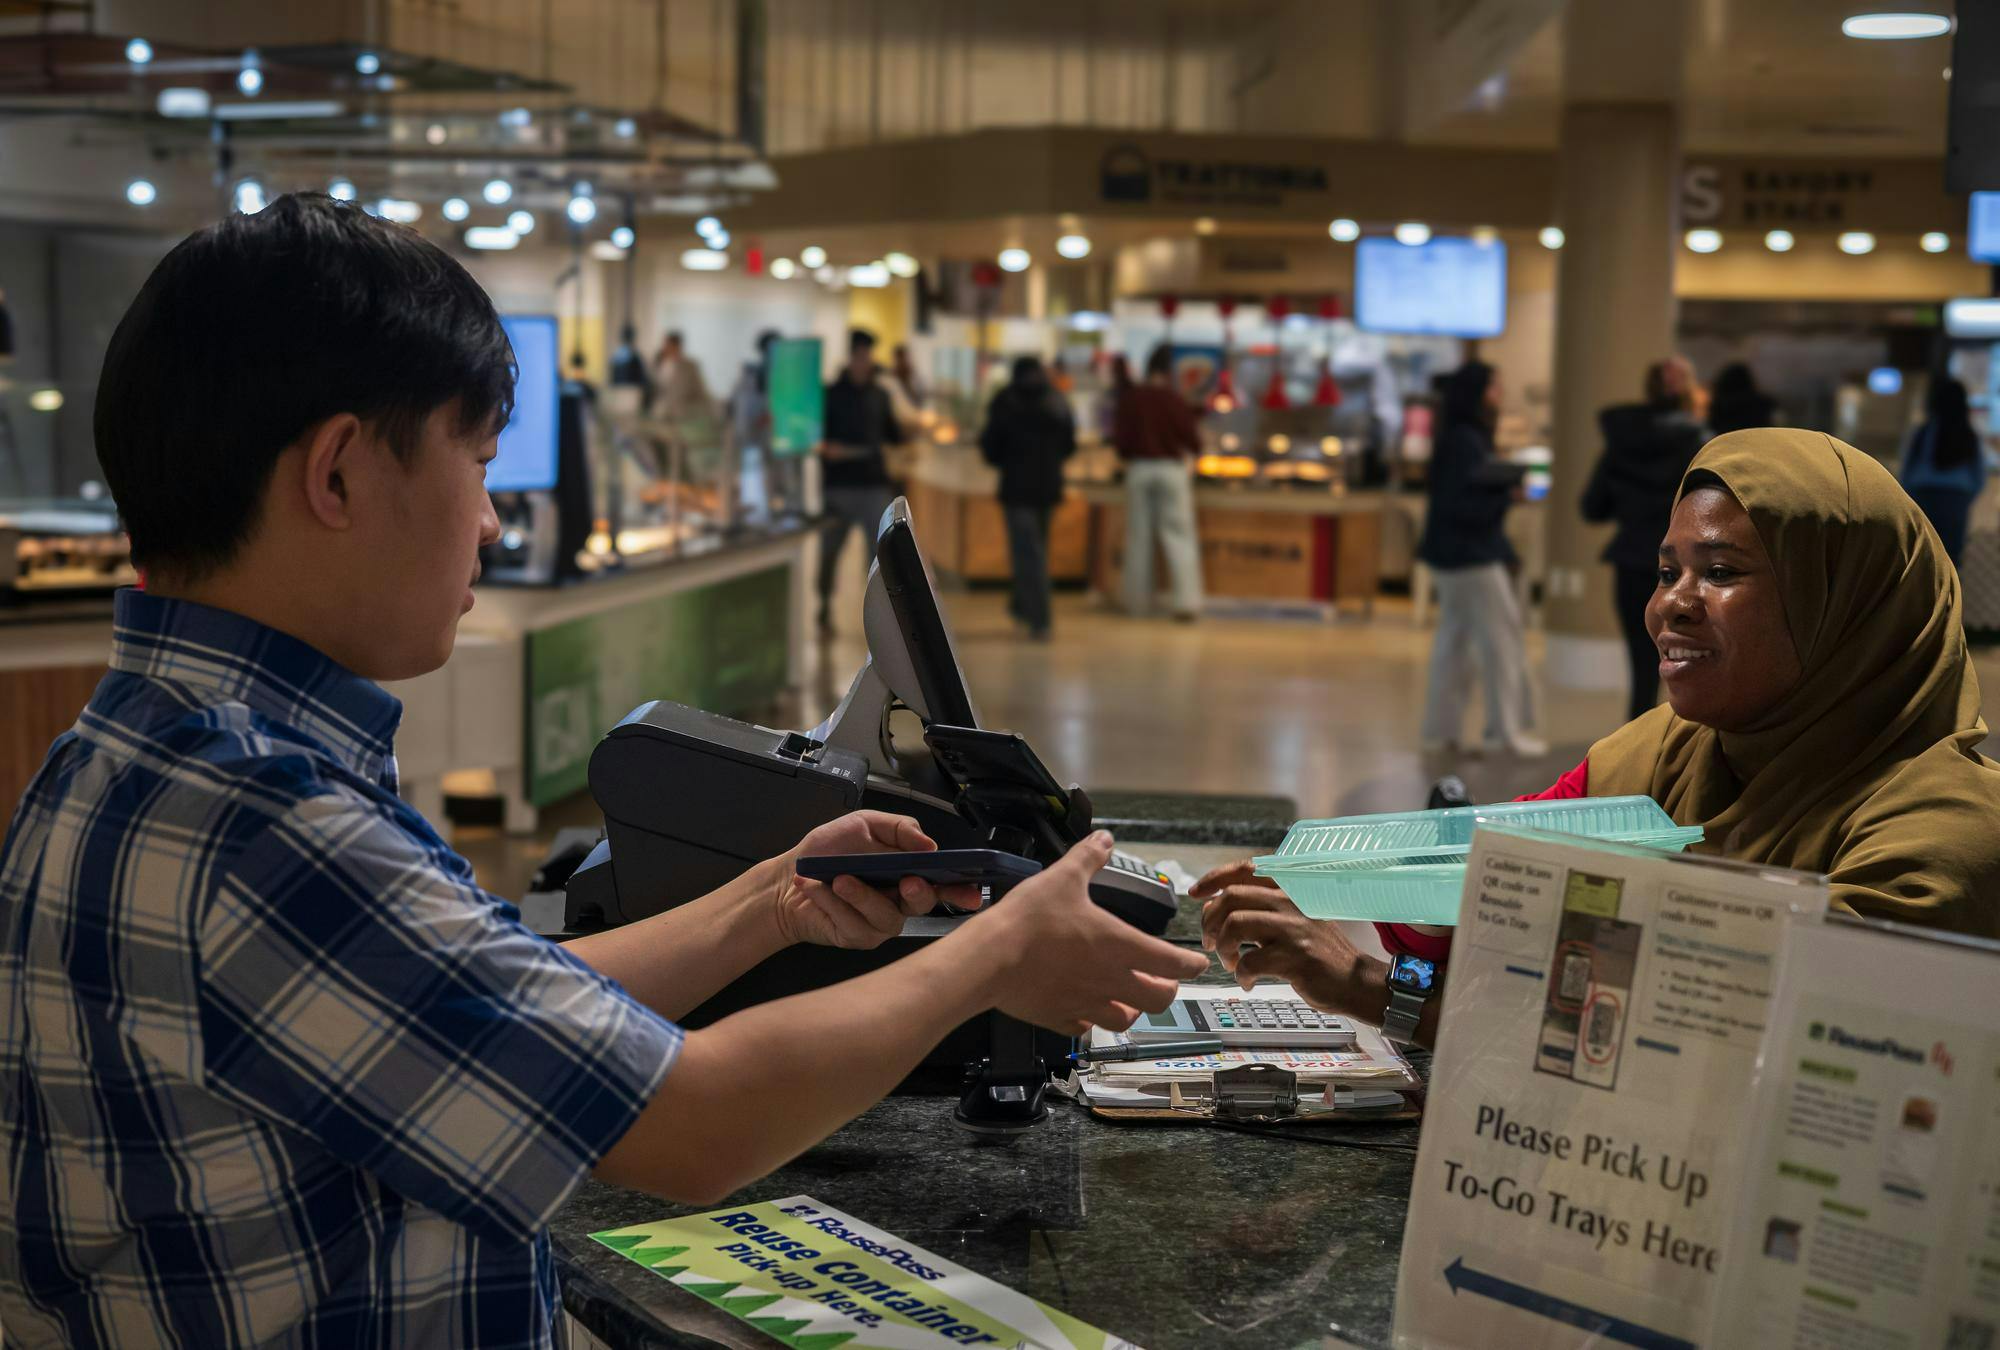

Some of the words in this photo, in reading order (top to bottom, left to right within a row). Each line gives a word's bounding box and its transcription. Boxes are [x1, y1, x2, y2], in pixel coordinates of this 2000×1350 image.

[1683, 165, 1721, 220] S
[1156, 1062, 1221, 1070] 2025
[1475, 1104, 1570, 1162] Please
[1581, 1128, 1645, 1183] Pick
[1659, 1154, 1708, 1207] Up
[806, 1216, 947, 1283] ReusePass
[1443, 1160, 1535, 1217] To-Go
[1548, 1193, 1630, 1252] Trays
[1642, 1218, 1718, 1272] Here
[709, 1211, 822, 1263] Reuse
[817, 1260, 1000, 1346] Container
[715, 1243, 814, 1293] Pick-up
[811, 1288, 883, 1329] Here.
